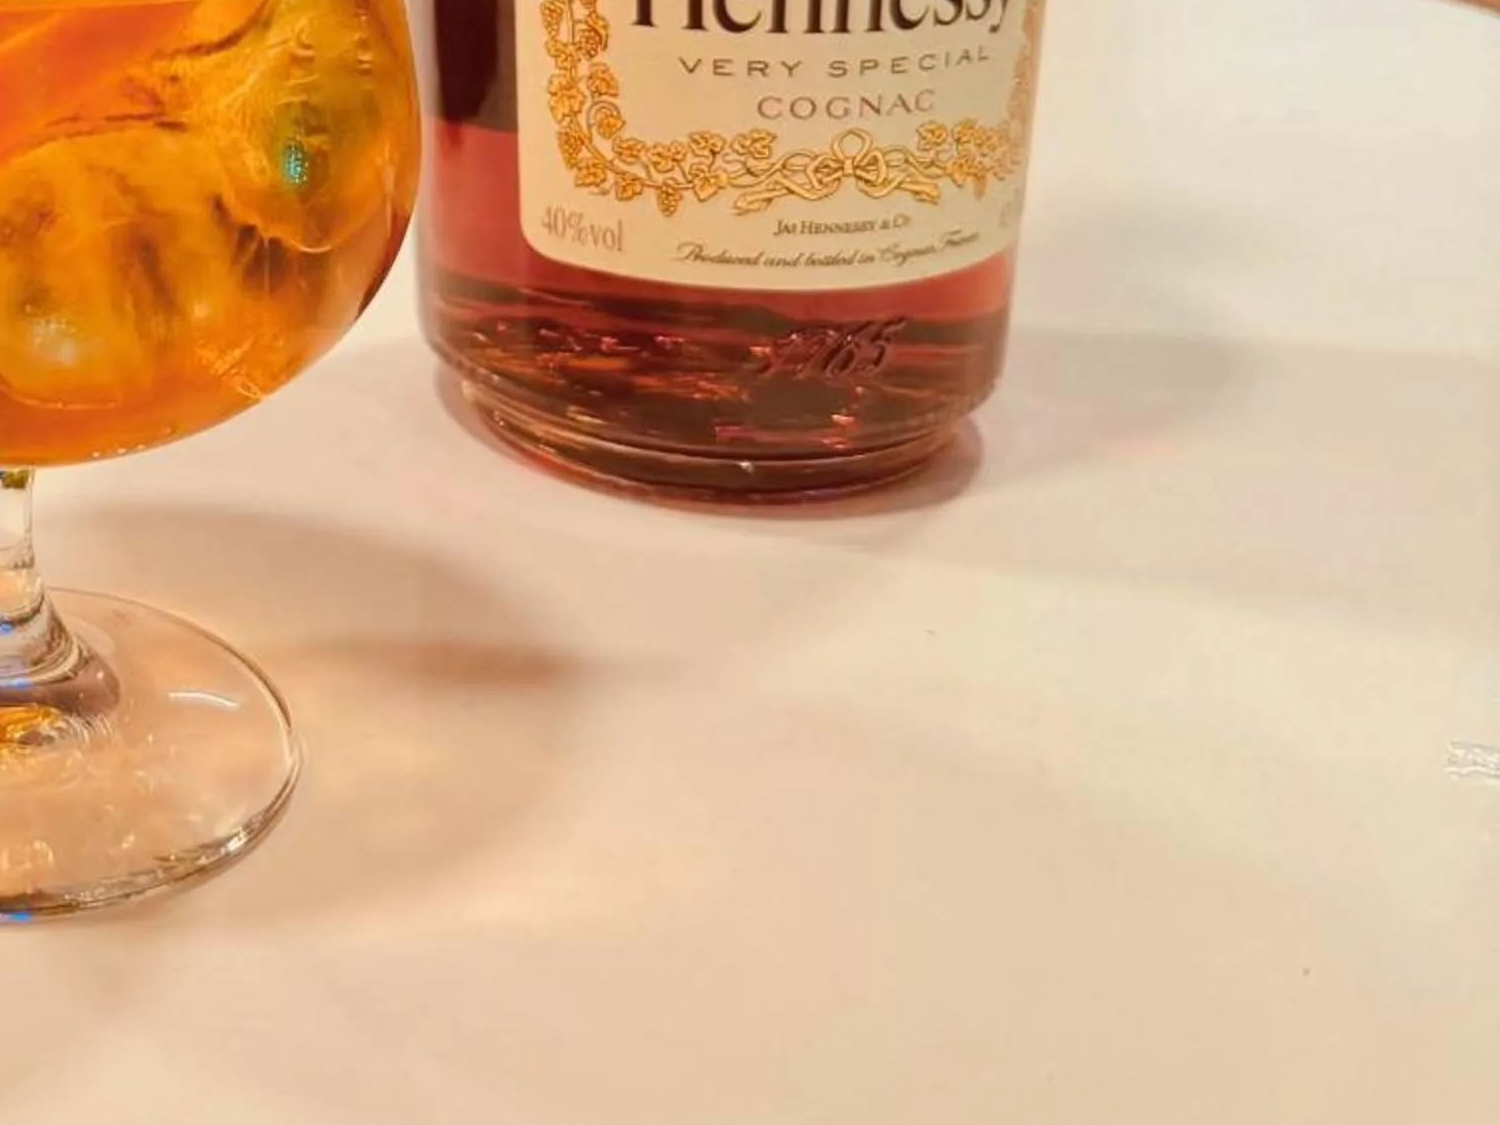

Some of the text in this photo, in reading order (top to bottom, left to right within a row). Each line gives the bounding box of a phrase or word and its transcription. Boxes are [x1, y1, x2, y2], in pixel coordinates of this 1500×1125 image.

[678, 44, 991, 78] VERY SPECIAL
[756, 88, 936, 121] COGNAC
[675, 240, 763, 267] Produced
[763, 252, 802, 268] and
[804, 249, 858, 267] bottled
[856, 250, 876, 266] in
